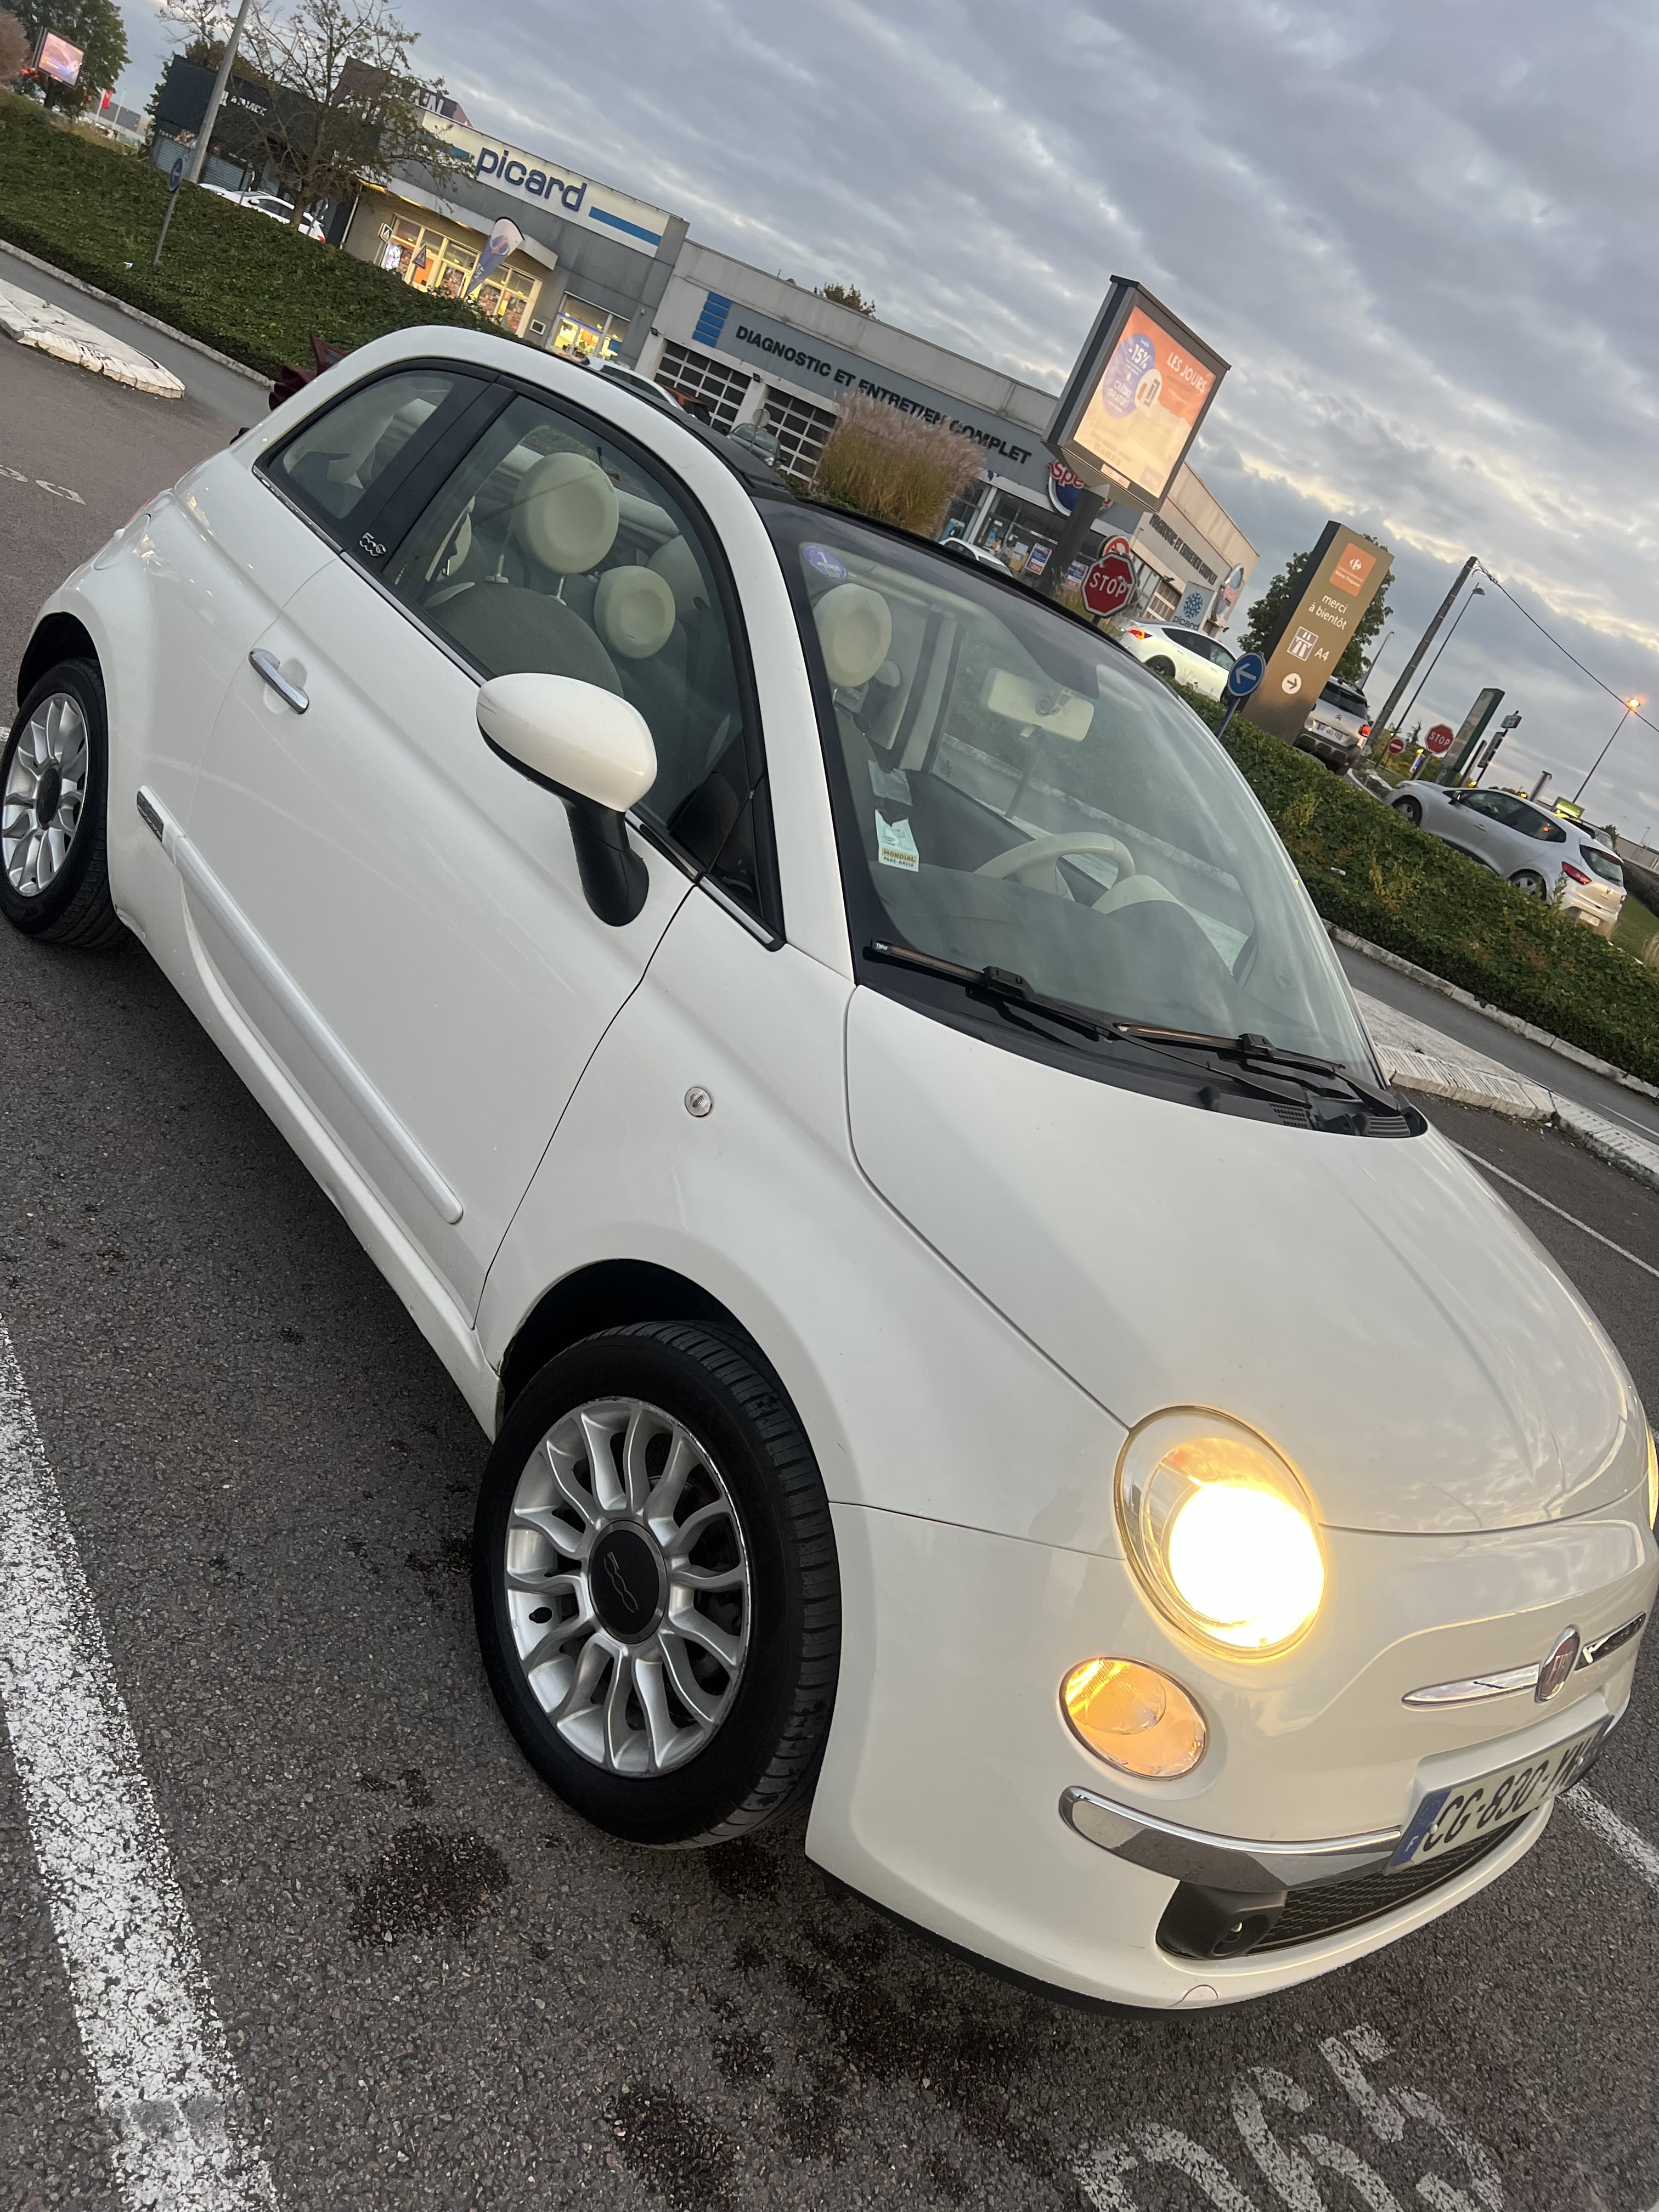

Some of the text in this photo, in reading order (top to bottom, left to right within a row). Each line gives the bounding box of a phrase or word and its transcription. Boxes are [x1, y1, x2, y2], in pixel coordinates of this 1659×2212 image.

[475, 147, 588, 212] picard
[1166, 352, 1183, 372] LES
[1180, 365, 1207, 393] JOURS
[736, 325, 832, 377] DIAGNOSTIC
[833, 369, 856, 387] ET
[949, 420, 1032, 464] COMPLET
[1089, 572, 1127, 597] STOP
[1322, 595, 1348, 614] merci
[1172, 615, 1200, 631] picard
[1308, 602, 1347, 630] à bientôt
[1314, 647, 1330, 662] A4
[1429, 731, 1451, 747] STOP
[884, 850, 916, 862] MONDIAL
